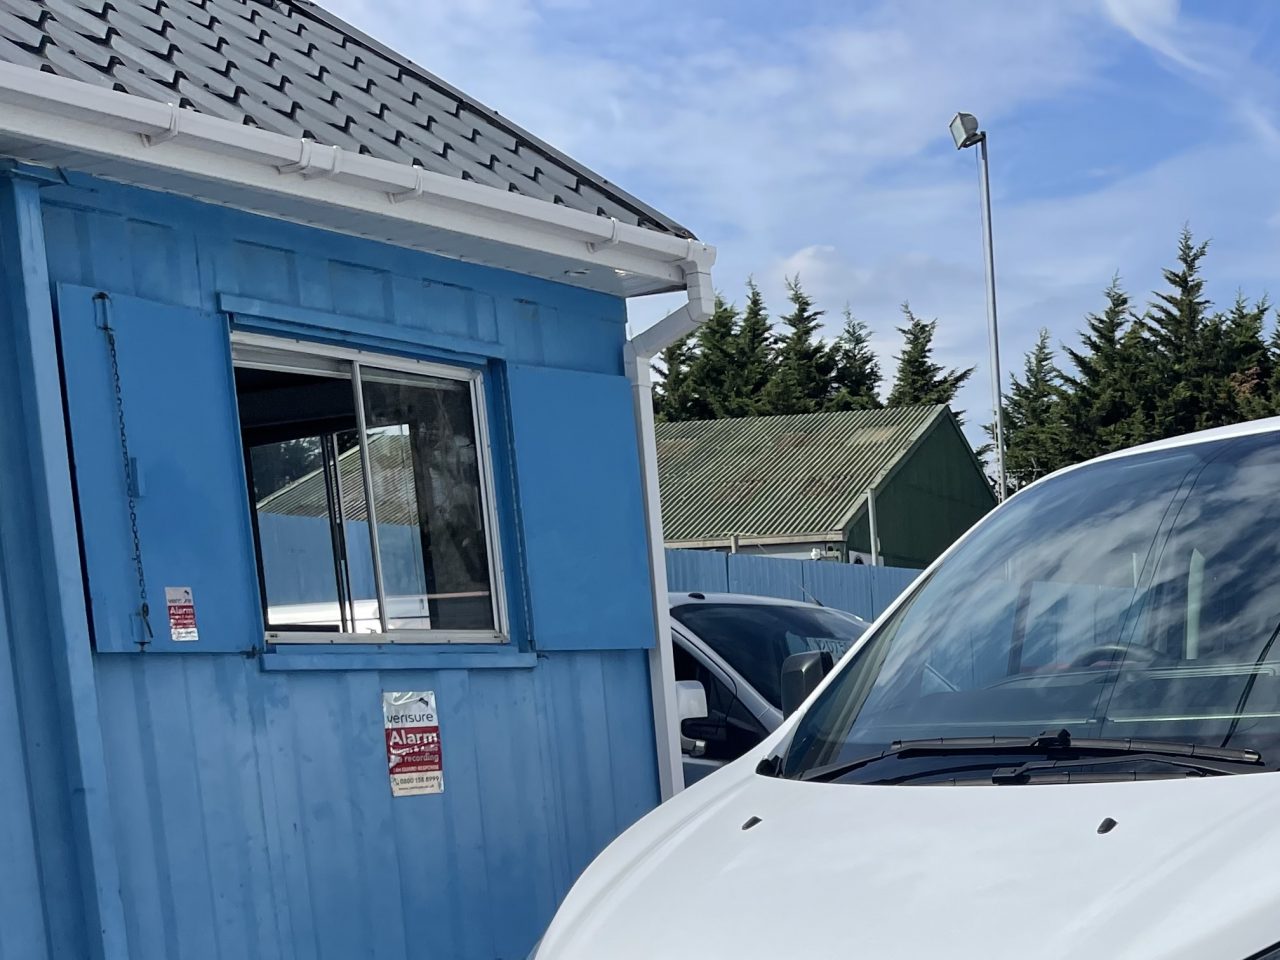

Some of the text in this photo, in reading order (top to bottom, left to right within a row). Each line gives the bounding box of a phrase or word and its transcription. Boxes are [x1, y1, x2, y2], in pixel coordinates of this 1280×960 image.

[387, 713, 434, 724] verisure
[390, 729, 438, 746] Alarm
[404, 753, 439, 762] recording
